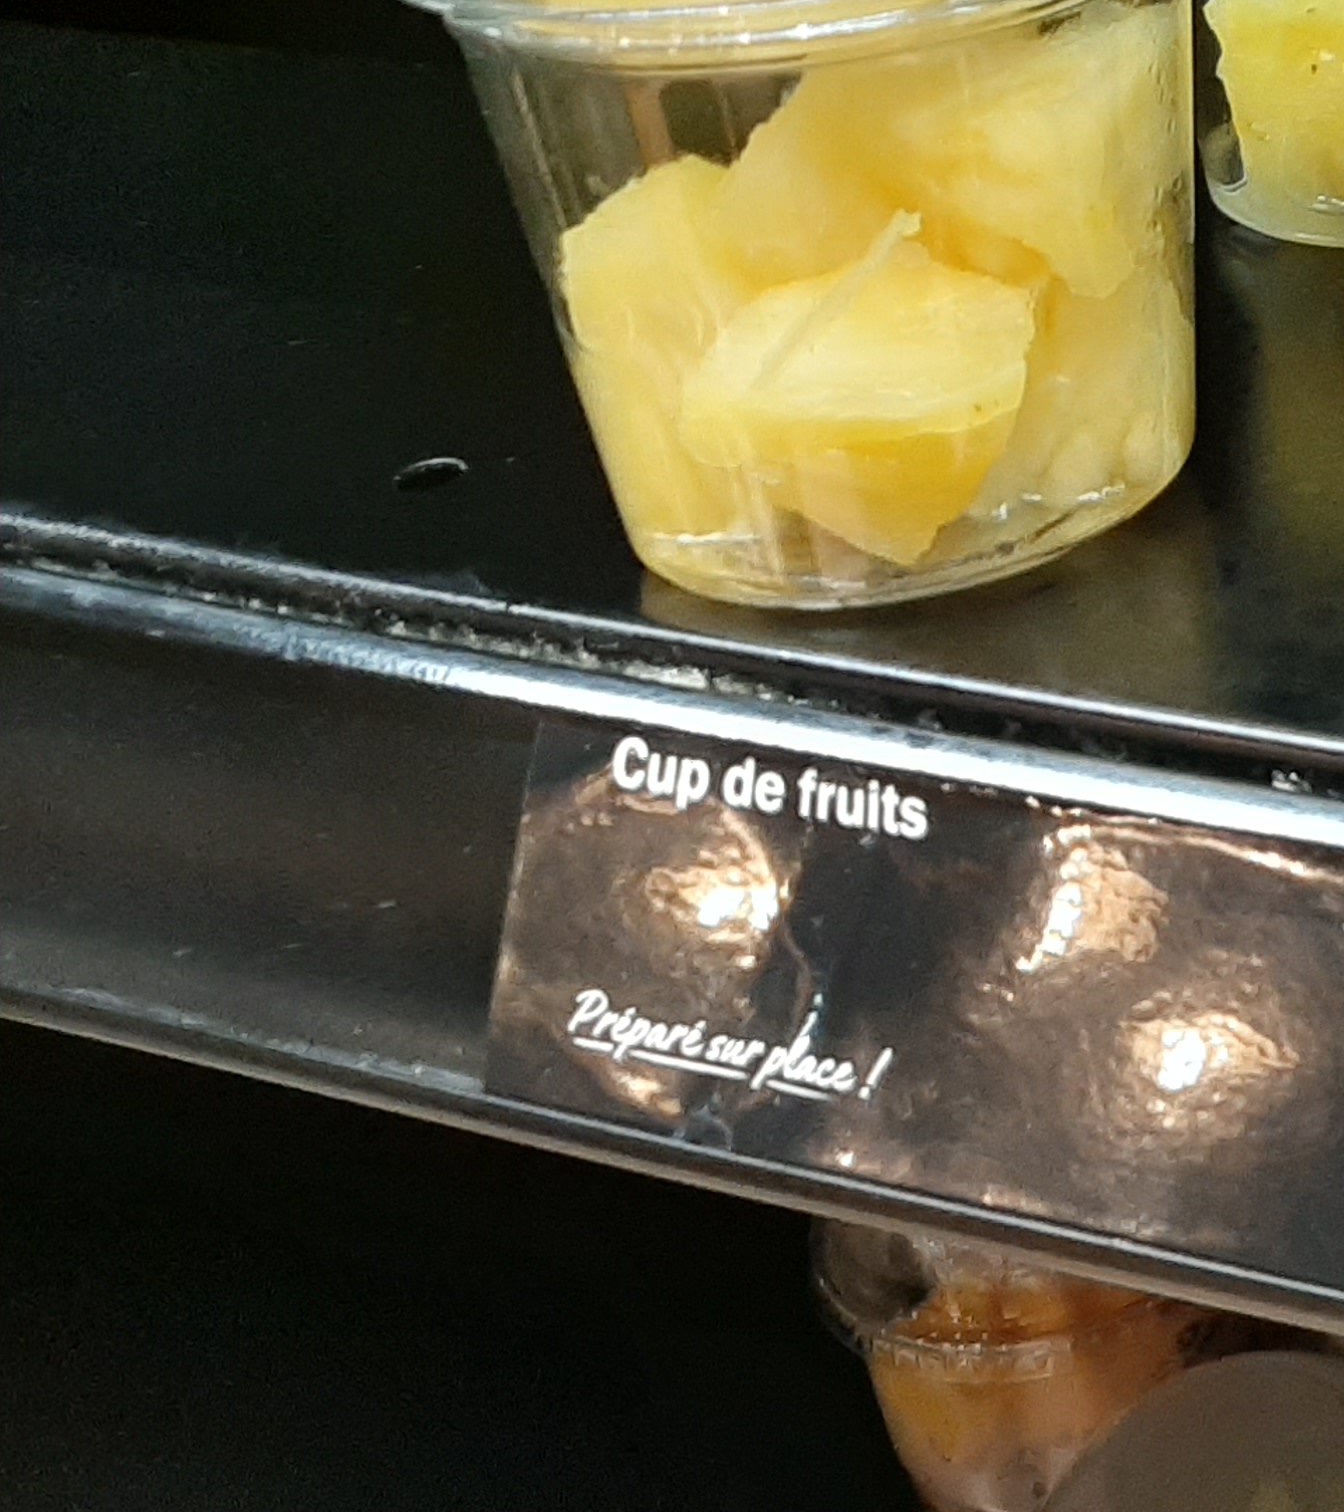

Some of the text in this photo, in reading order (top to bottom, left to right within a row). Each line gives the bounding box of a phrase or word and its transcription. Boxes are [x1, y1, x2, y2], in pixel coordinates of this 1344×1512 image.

[612, 735, 929, 841] Cup de fruits
[567, 988, 706, 1063] Préparé
[705, 1034, 765, 1068] sur
[750, 1010, 856, 1091] place
